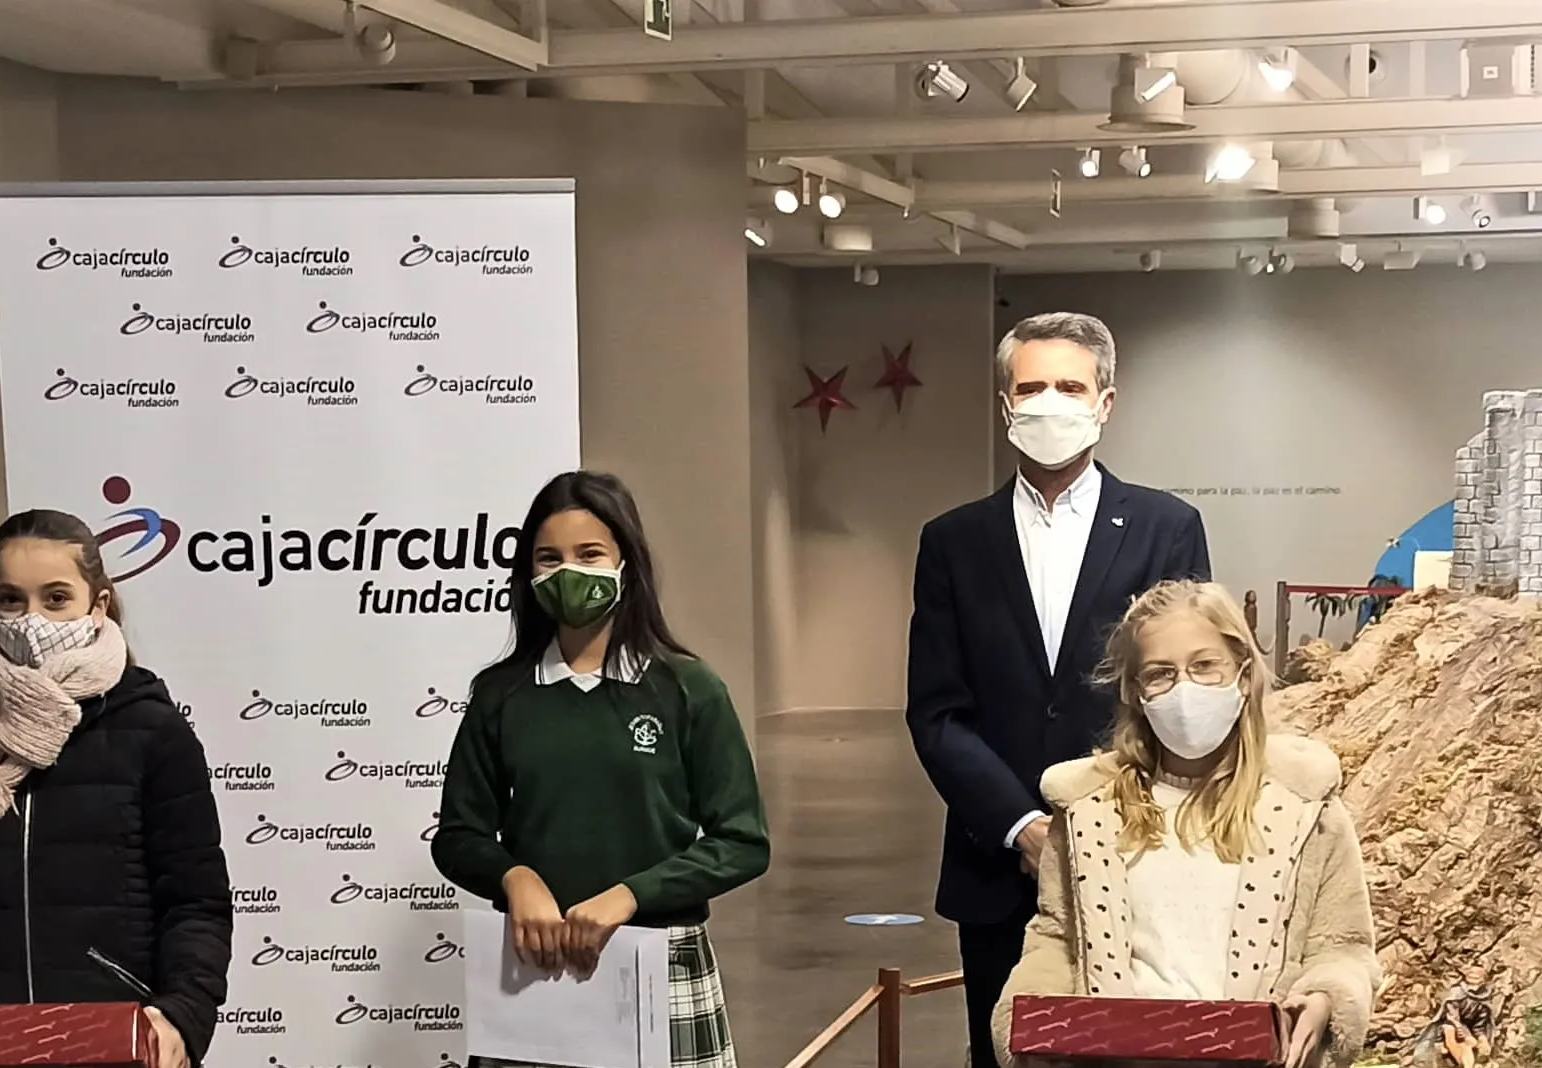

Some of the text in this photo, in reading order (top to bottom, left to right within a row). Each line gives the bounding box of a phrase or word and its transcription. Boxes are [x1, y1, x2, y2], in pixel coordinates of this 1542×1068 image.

[72, 248, 169, 270] cajacírculo
[254, 246, 350, 268] cajacírculo
[434, 245, 530, 266] cajacírculo
[120, 267, 173, 278] fundación
[302, 265, 353, 276] fundación
[482, 264, 533, 275] fundación
[155, 313, 252, 335] cajacírculo
[341, 312, 437, 333] cajacírculo
[203, 332, 255, 343] fundación
[389, 330, 440, 341] fundación
[79, 378, 176, 400] cajacírculo
[260, 376, 355, 398] cajacírculo
[439, 375, 533, 396] cajacírculo
[127, 397, 179, 408] fundación
[307, 395, 358, 406] fundación
[485, 393, 537, 404] fundación
[187, 511, 525, 587] cajacírculo
[358, 580, 511, 615] fundació
[274, 698, 368, 720] cajacírculo
[321, 717, 371, 727] fundación
[207, 763, 271, 779] acírculo
[225, 781, 275, 791] fundación
[405, 779, 443, 788] fundaci
[279, 823, 372, 844] cajacírculo
[326, 841, 376, 851] fundación
[364, 882, 456, 903] cajacírculo
[409, 899, 460, 911] fundación
[285, 944, 378, 965] cajacírculo
[331, 961, 381, 972] fundación
[217, 1007, 283, 1022] acírculo
[369, 1003, 460, 1024] cajacírculo
[236, 1024, 286, 1034] fundación
[414, 1020, 464, 1031] fundación
